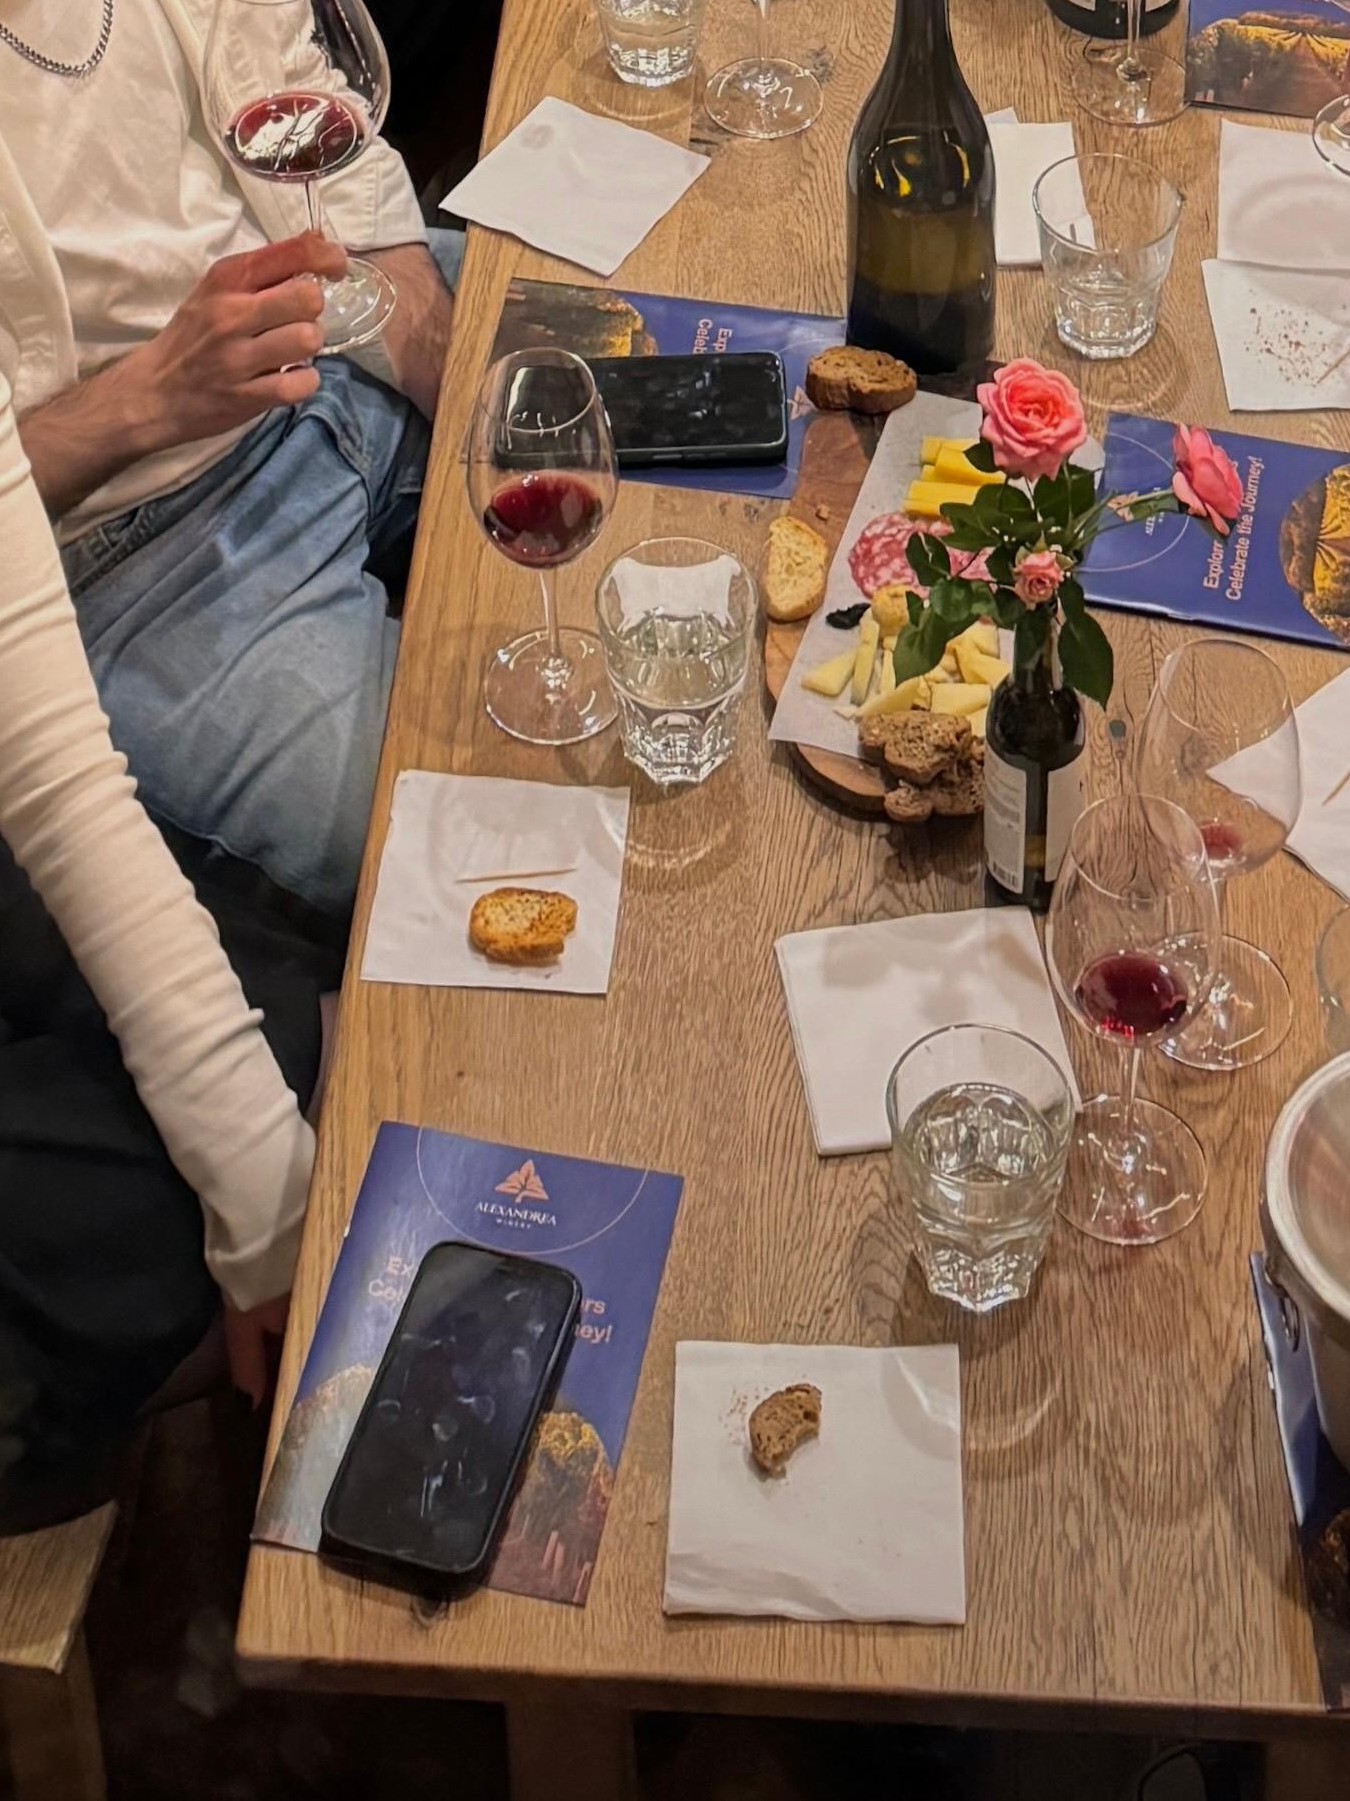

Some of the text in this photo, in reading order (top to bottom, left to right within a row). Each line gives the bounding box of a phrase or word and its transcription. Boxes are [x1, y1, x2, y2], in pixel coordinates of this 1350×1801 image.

[1225, 455, 1266, 600] Celebrate the Journey!
[474, 1201, 557, 1227] ALEXANDREA
